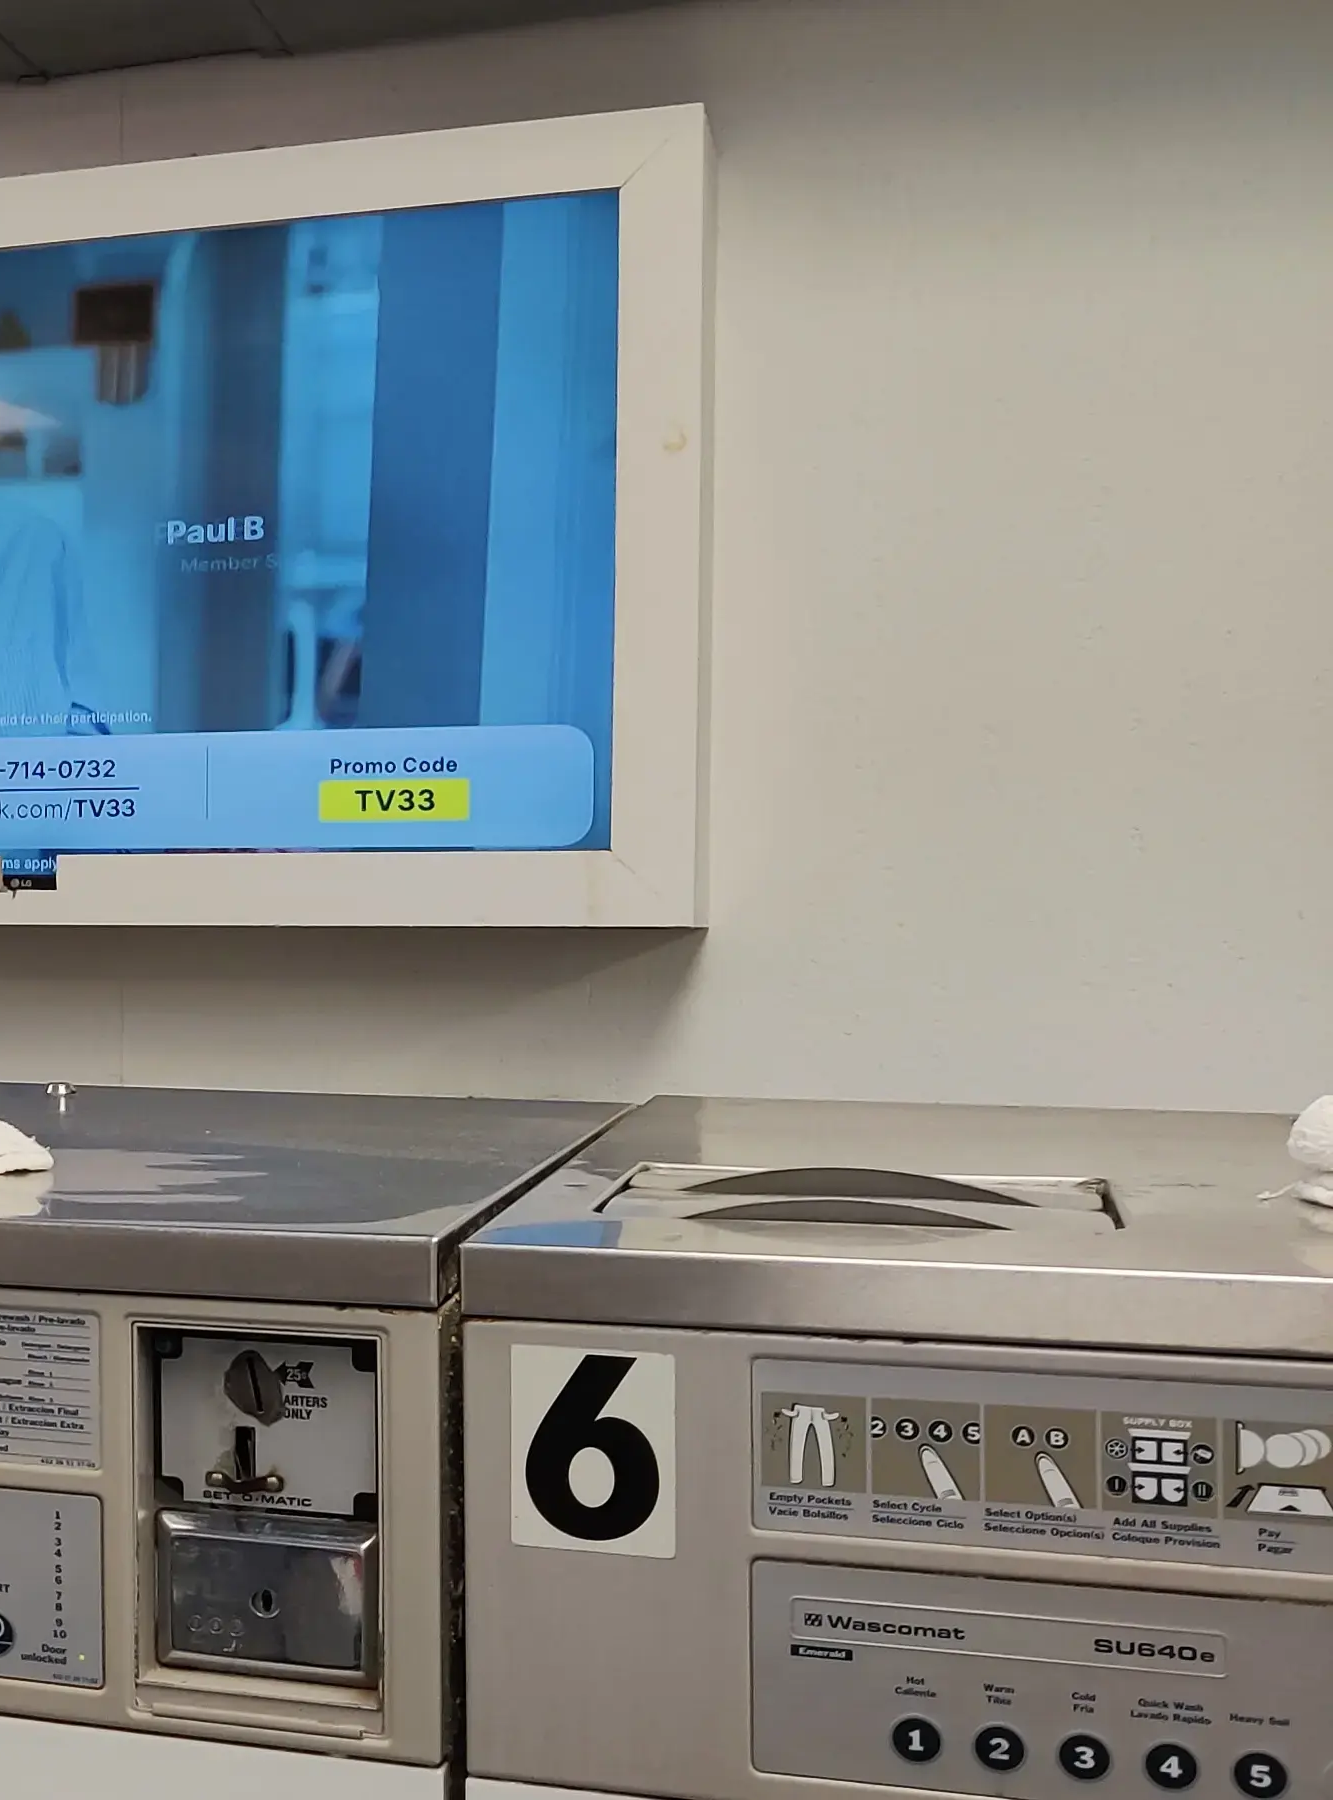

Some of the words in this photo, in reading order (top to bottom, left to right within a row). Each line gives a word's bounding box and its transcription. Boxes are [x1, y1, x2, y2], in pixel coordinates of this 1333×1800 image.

[166, 517, 234, 544] Paul
[244, 516, 264, 540] B
[180, 555, 257, 573] Member
[20, 715, 37, 725] for
[41, 714, 68, 724] their
[71, 711, 152, 726] participation.
[330, 757, 396, 774] Promo
[403, 757, 457, 773] Code
[355, 789, 436, 811] TV33
[284, 1395, 327, 1408] ARTERS
[285, 1407, 312, 1419] ONLY
[1123, 1416, 1165, 1427] SUPPLY
[1169, 1419, 1192, 1428] BOX
[872, 1421, 884, 1434] 2
[901, 1422, 914, 1436] 3
[933, 1425, 947, 1437] 4
[967, 1426, 980, 1440] 5
[1016, 1429, 1030, 1443] A
[1050, 1431, 1064, 1446] B
[525, 1354, 659, 1540] 6
[770, 1492, 803, 1504] Empty
[808, 1494, 851, 1506] Pockets
[769, 1507, 798, 1518] Vacie
[803, 1509, 848, 1520] Bolsillos
[873, 1500, 907, 1511] Select
[912, 1502, 942, 1514] Cycle
[55, 1511, 60, 1519] 1
[872, 1514, 932, 1527] Seleccione
[936, 1519, 964, 1529] Ciclo
[985, 1508, 1021, 1520] Select
[1025, 1511, 1077, 1524] Option(s)
[54, 1522, 61, 1530] 2
[984, 1523, 1046, 1537] Seleccione
[1051, 1527, 1105, 1540] Opcion(s)
[1113, 1517, 1136, 1527] Add
[1141, 1519, 1156, 1528] All
[1161, 1520, 1211, 1533] Supplies
[1259, 1528, 1280, 1539] Pay
[55, 1538, 61, 1546] 3
[1113, 1532, 1160, 1545] Coloque
[1164, 1537, 1220, 1549] Provision
[55, 1549, 61, 1557] 4
[55, 1565, 61, 1573] 5
[55, 1576, 62, 1585] 6
[56, 1591, 62, 1600] 7
[55, 1603, 62, 1611] 8
[55, 1618, 62, 1627] 9
[828, 1614, 965, 1640] Wascomat
[53, 1629, 67, 1638] 10
[41, 1644, 66, 1654] Door
[799, 1647, 845, 1658] Emerald
[1094, 1638, 1215, 1662] SU640e
[21, 1653, 66, 1665] unlocked
[906, 1677, 924, 1685] Hot
[984, 1683, 1014, 1694] Warm
[1072, 1692, 1096, 1701] Cold
[1073, 1704, 1094, 1713] Fria
[1138, 1699, 1168, 1709] Quick
[1174, 1701, 1203, 1712] Wash
[1130, 1710, 1168, 1721] Lavado
[1173, 1714, 1212, 1726] Rapido
[1230, 1714, 1264, 1725] Heavy
[908, 1729, 924, 1751] 1
[988, 1738, 1009, 1760] 2
[1074, 1747, 1095, 1769] 3
[1160, 1756, 1182, 1778] 4
[1250, 1765, 1272, 1787] 5
